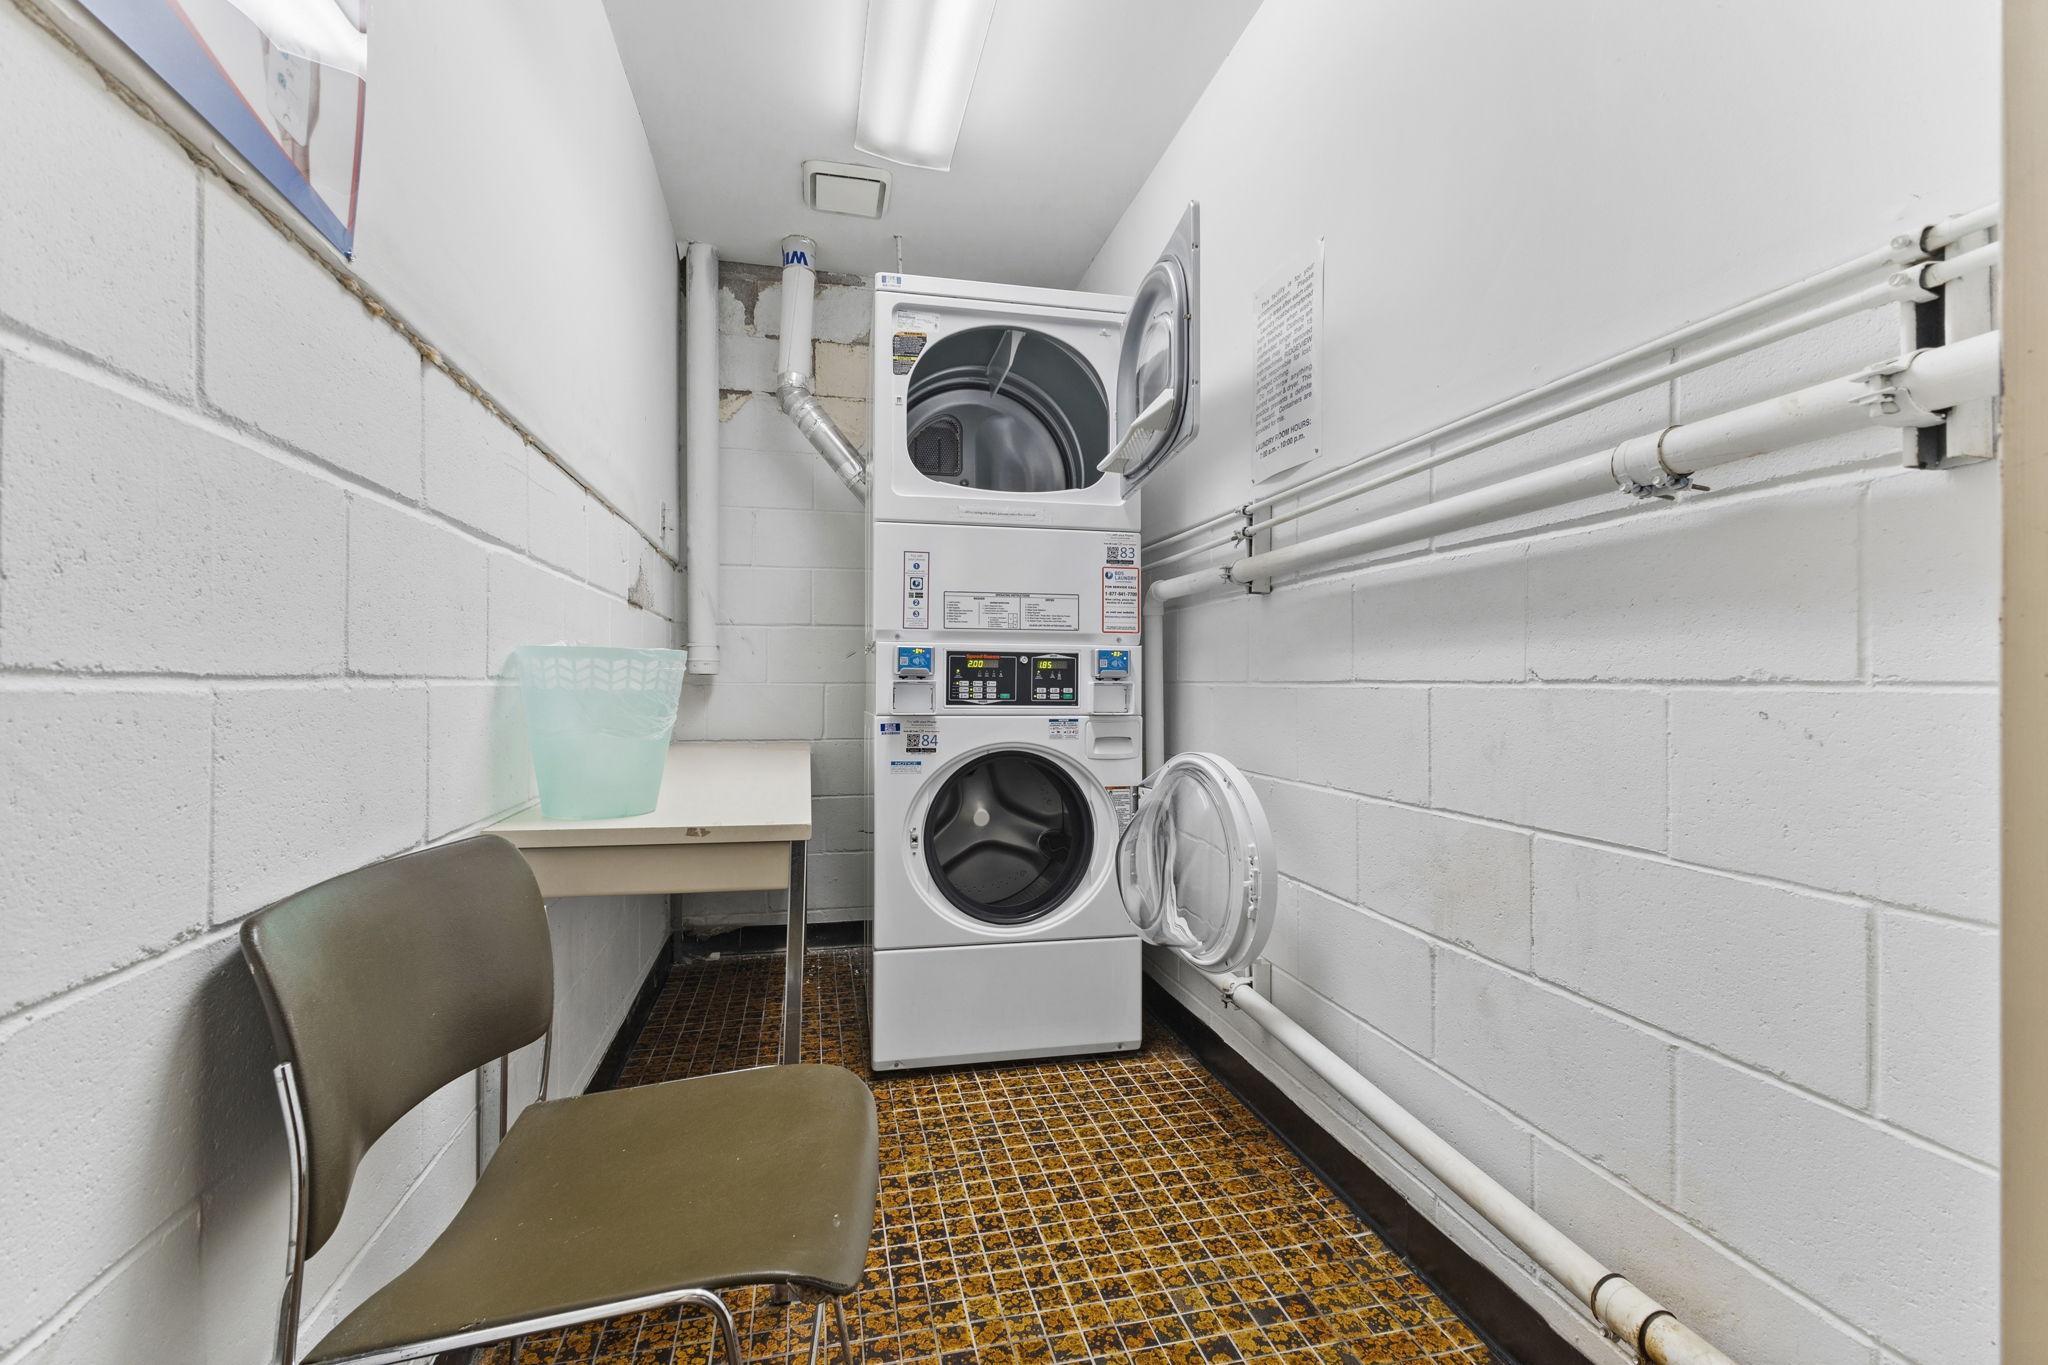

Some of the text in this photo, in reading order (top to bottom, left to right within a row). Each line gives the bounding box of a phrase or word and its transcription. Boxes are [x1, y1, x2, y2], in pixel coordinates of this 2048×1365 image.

[1271, 287, 1284, 300] facility
[1303, 263, 1314, 274] your
[1297, 272, 1313, 287] Please
[1284, 336, 1312, 357] RIDGEVIEW
[1290, 364, 1312, 381] anything
[1301, 371, 1312, 382] This
[1294, 381, 1312, 395] definite
[1279, 396, 1302, 412] Containers
[1303, 391, 1312, 399] are
[1255, 417, 1312, 451] LAUNDRY ROOM HOURS:
[1280, 437, 1293, 448] 10:00
[1293, 433, 1305, 443] p.m.
[1120, 546, 1135, 559] 83
[921, 734, 938, 747] 84
